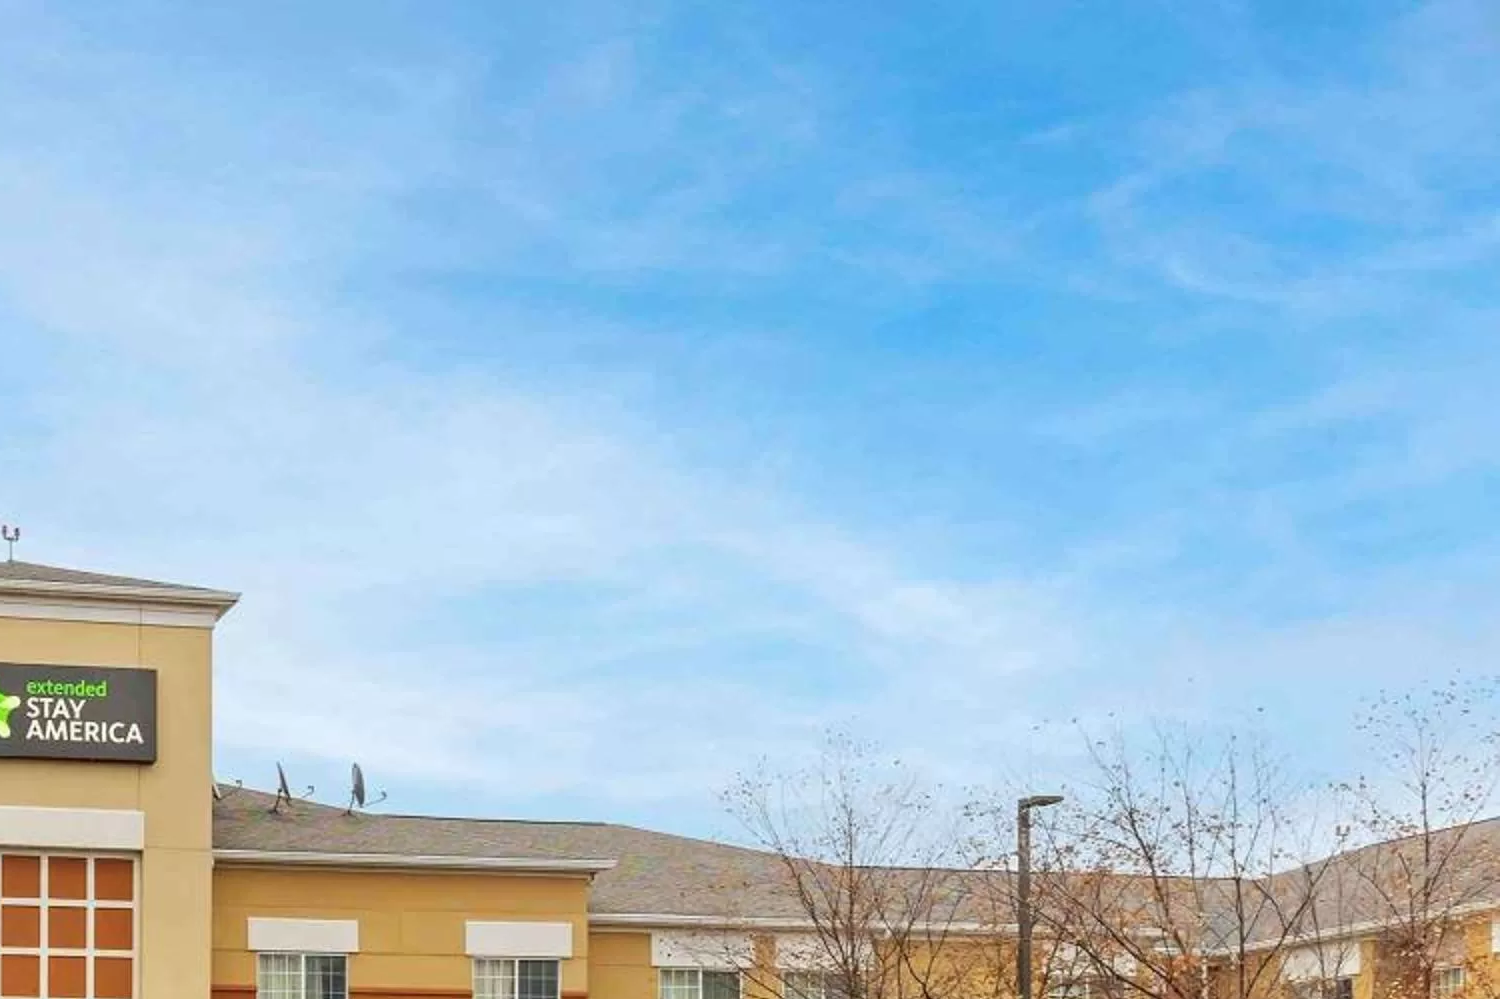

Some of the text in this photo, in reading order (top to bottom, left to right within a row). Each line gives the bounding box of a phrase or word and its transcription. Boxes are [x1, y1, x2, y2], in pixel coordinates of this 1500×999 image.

[26, 679, 107, 697] extended
[25, 697, 87, 719] STAY
[25, 719, 144, 744] AMERICA
